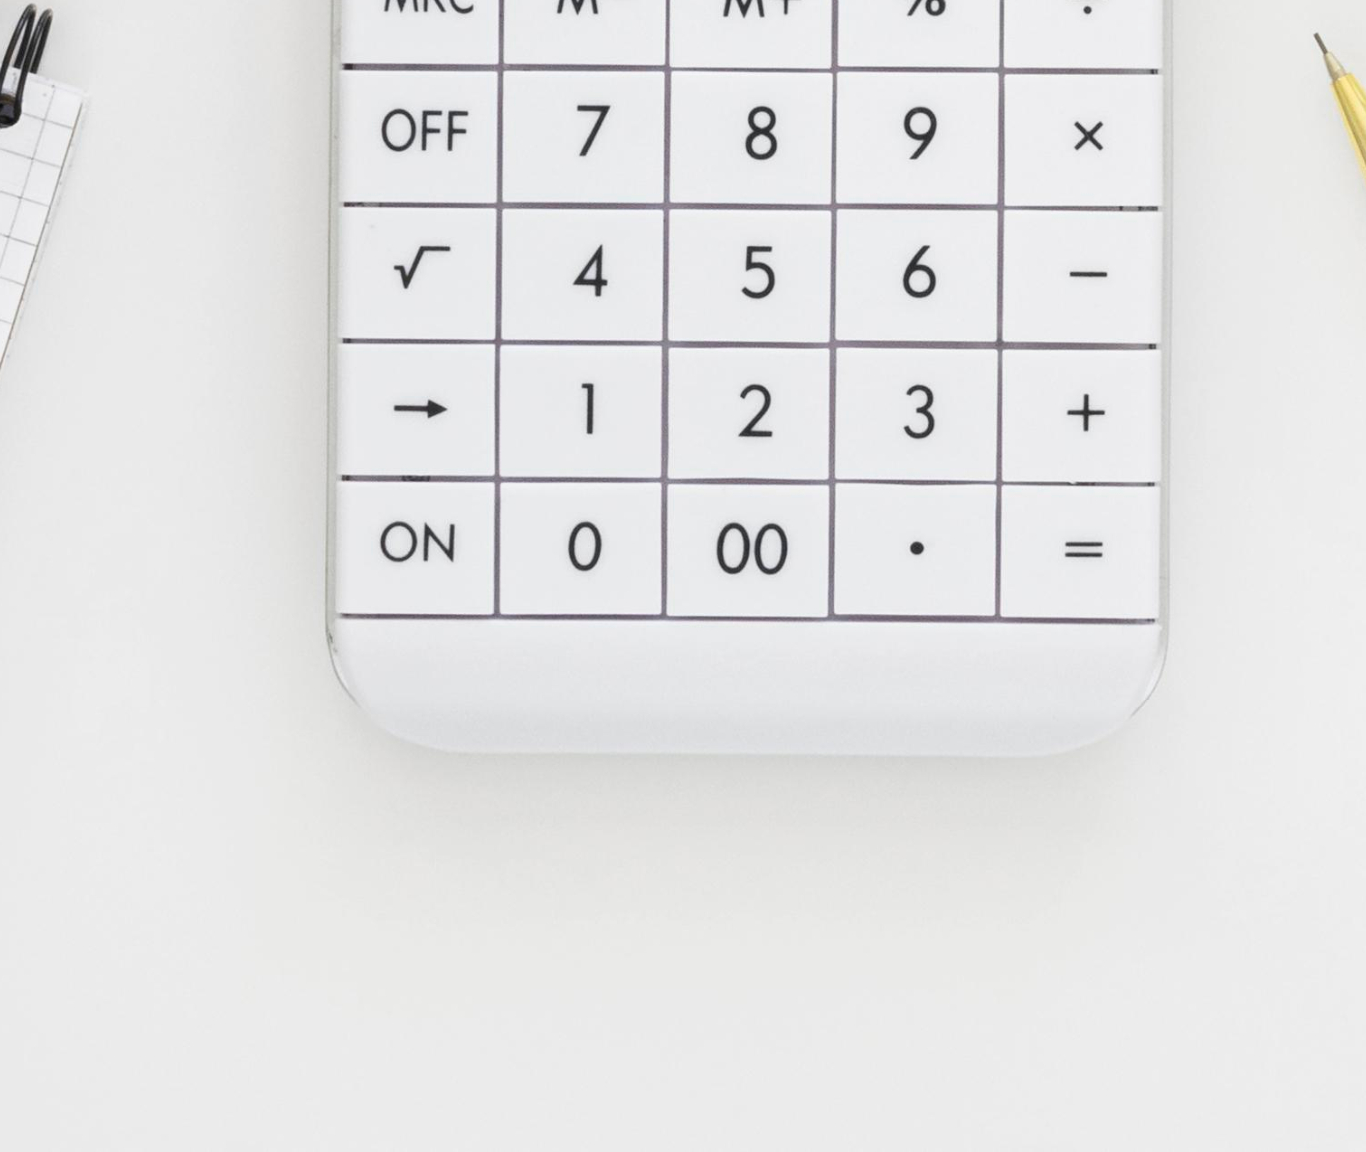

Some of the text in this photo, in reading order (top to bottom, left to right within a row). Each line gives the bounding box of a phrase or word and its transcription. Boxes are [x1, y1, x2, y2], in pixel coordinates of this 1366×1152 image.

[380, 108, 469, 153] OFF
[576, 104, 611, 157] 7
[744, 105, 778, 161] 8
[903, 106, 938, 160] 9
[572, 244, 609, 298] 4
[741, 245, 776, 300] 5
[902, 244, 937, 299] 6
[581, 382, 595, 435] 1
[738, 383, 773, 438] 2
[903, 384, 936, 440] 3
[379, 520, 456, 563] ON
[567, 521, 603, 572] 0
[716, 522, 789, 576] 00
